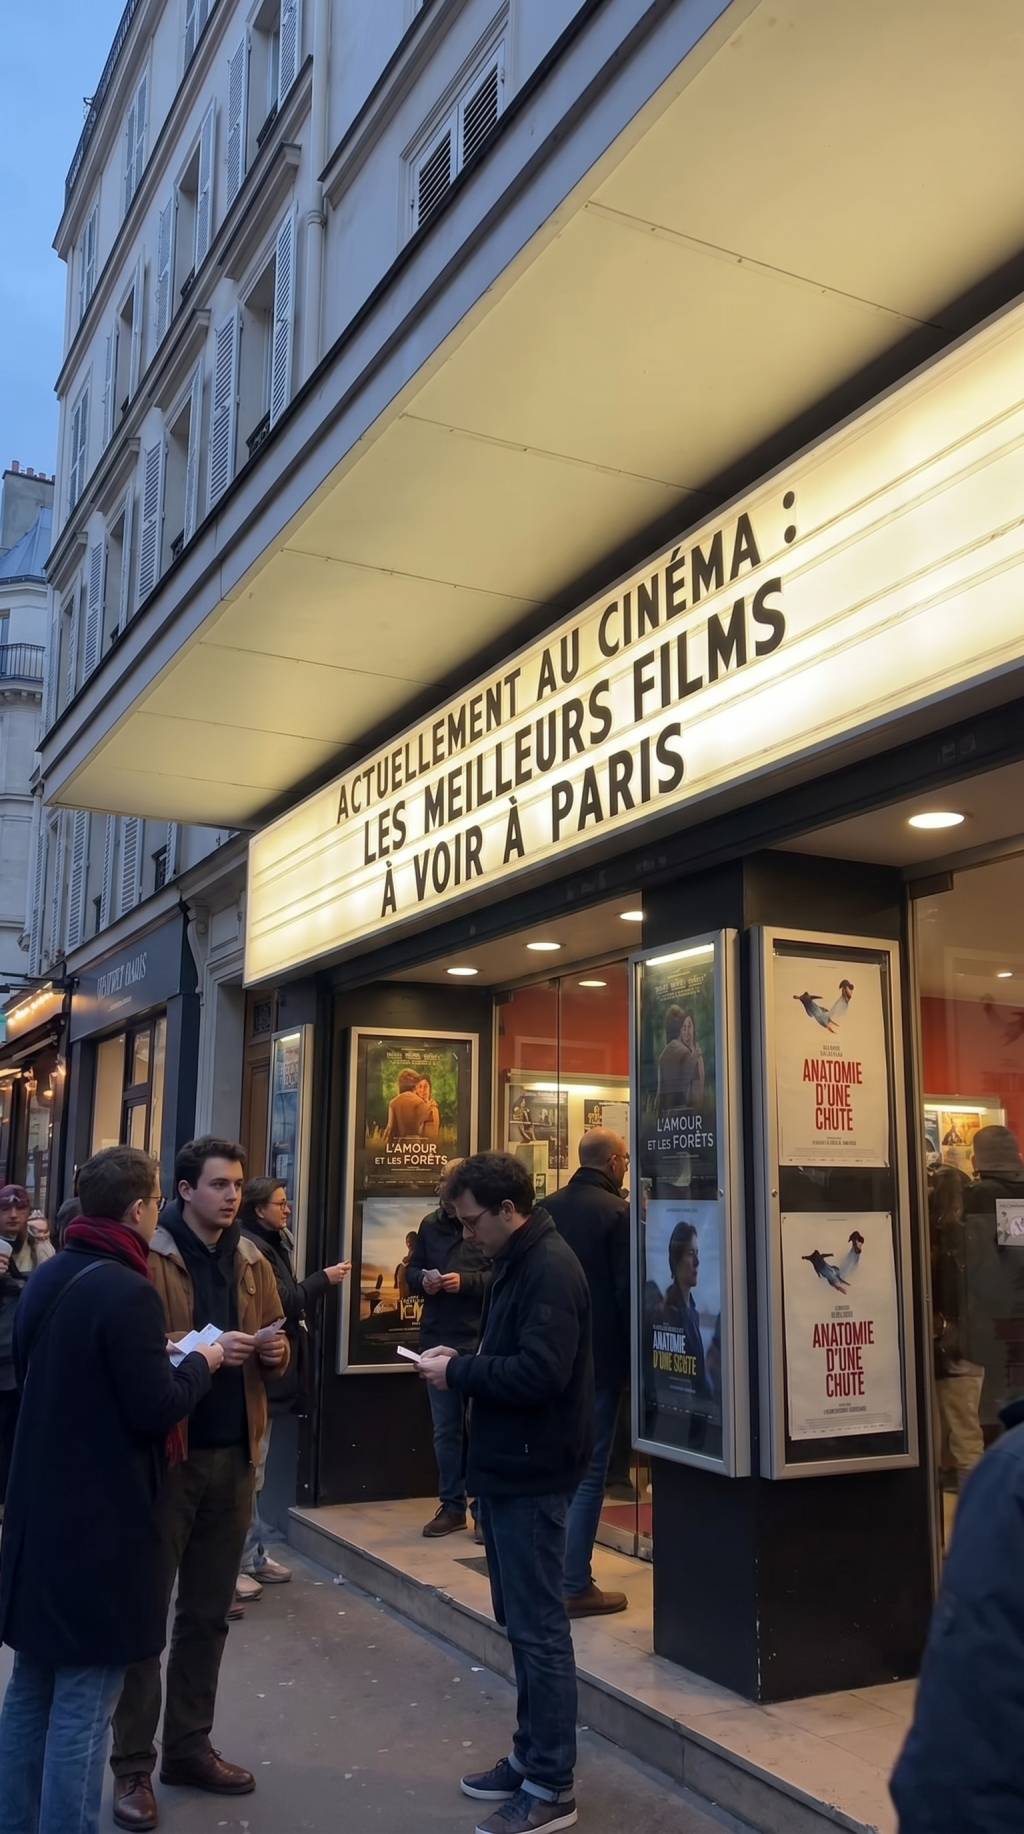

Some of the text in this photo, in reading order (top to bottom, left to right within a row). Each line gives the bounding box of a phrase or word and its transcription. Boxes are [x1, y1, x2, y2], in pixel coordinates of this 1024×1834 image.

[336, 667, 521, 825] ACTUELLEMENT
[537, 626, 580, 702] AU
[597, 511, 762, 658] CINÉMA
[363, 577, 787, 866] LES MEILLEURS FILMS
[381, 722, 685, 918] À VOIR À PARIS
[803, 1058, 863, 1084] ANATOMIE
[816, 1083, 851, 1107] D'UNE
[657, 1115, 703, 1132] L'AMOUR
[815, 1107, 853, 1131] CHUTE
[386, 1143, 437, 1154] L'AMOUR
[647, 1130, 714, 1150] ET LES FORÊTS
[375, 1152, 448, 1165] ET LES FORÊTS
[812, 1321, 874, 1348] ANATOMIE
[826, 1346, 863, 1373] D'UNE
[826, 1371, 865, 1398] CHUTE
